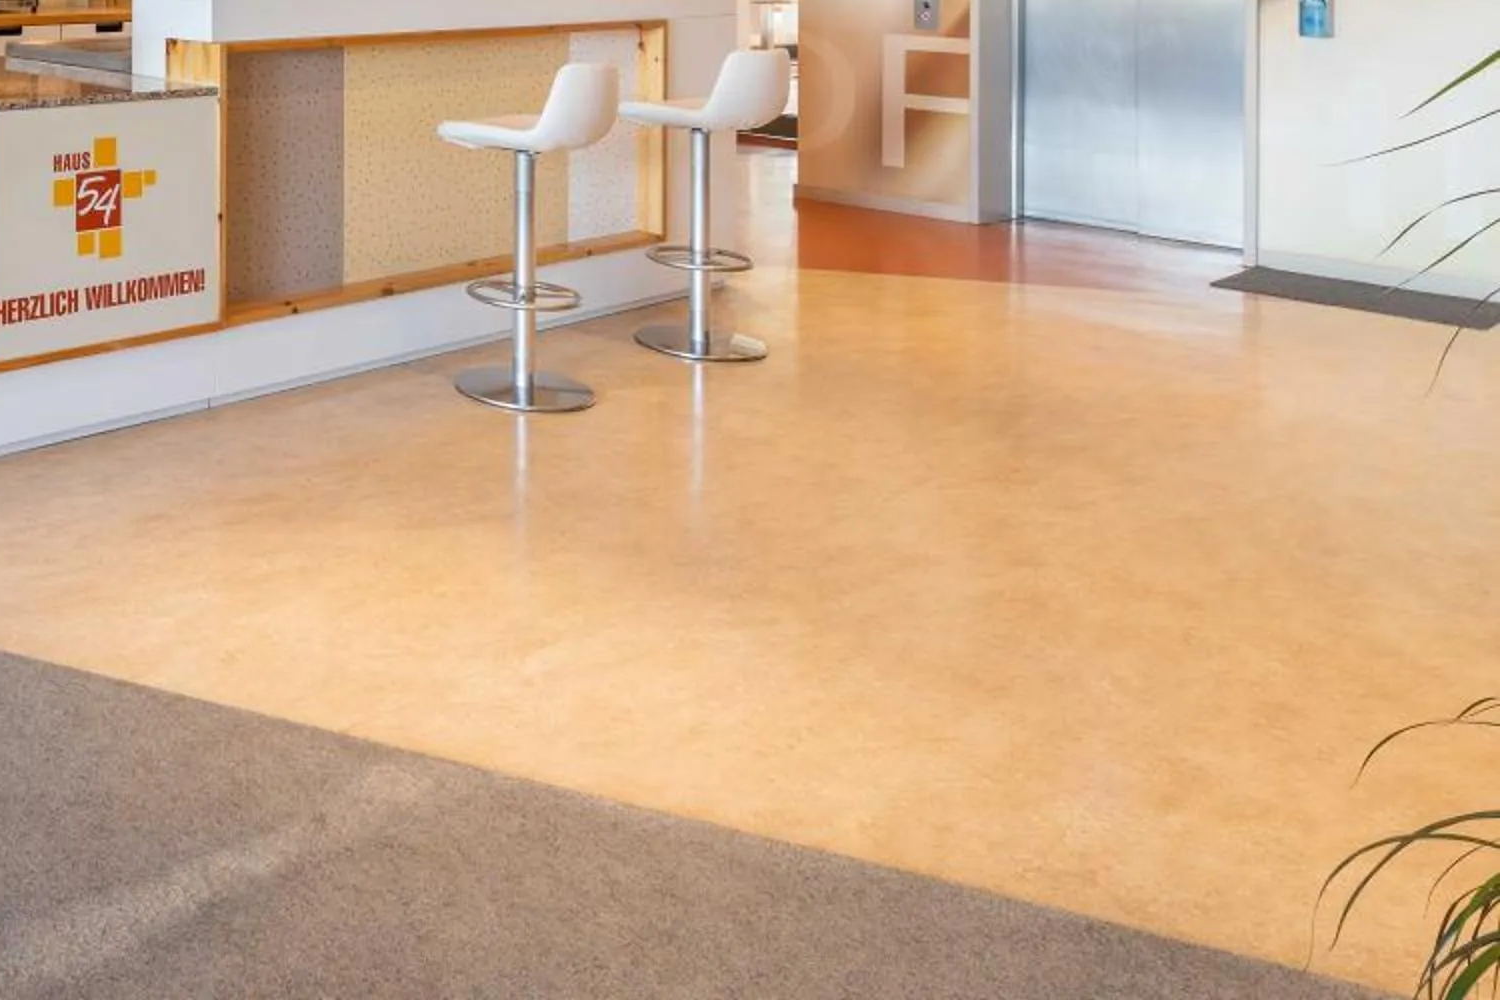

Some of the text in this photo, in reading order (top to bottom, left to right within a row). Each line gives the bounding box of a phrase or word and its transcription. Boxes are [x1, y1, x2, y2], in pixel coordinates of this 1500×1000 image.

[53, 151, 91, 173] HAUS
[77, 175, 121, 225] 54
[84, 268, 206, 310] WILLKOMMEN!
